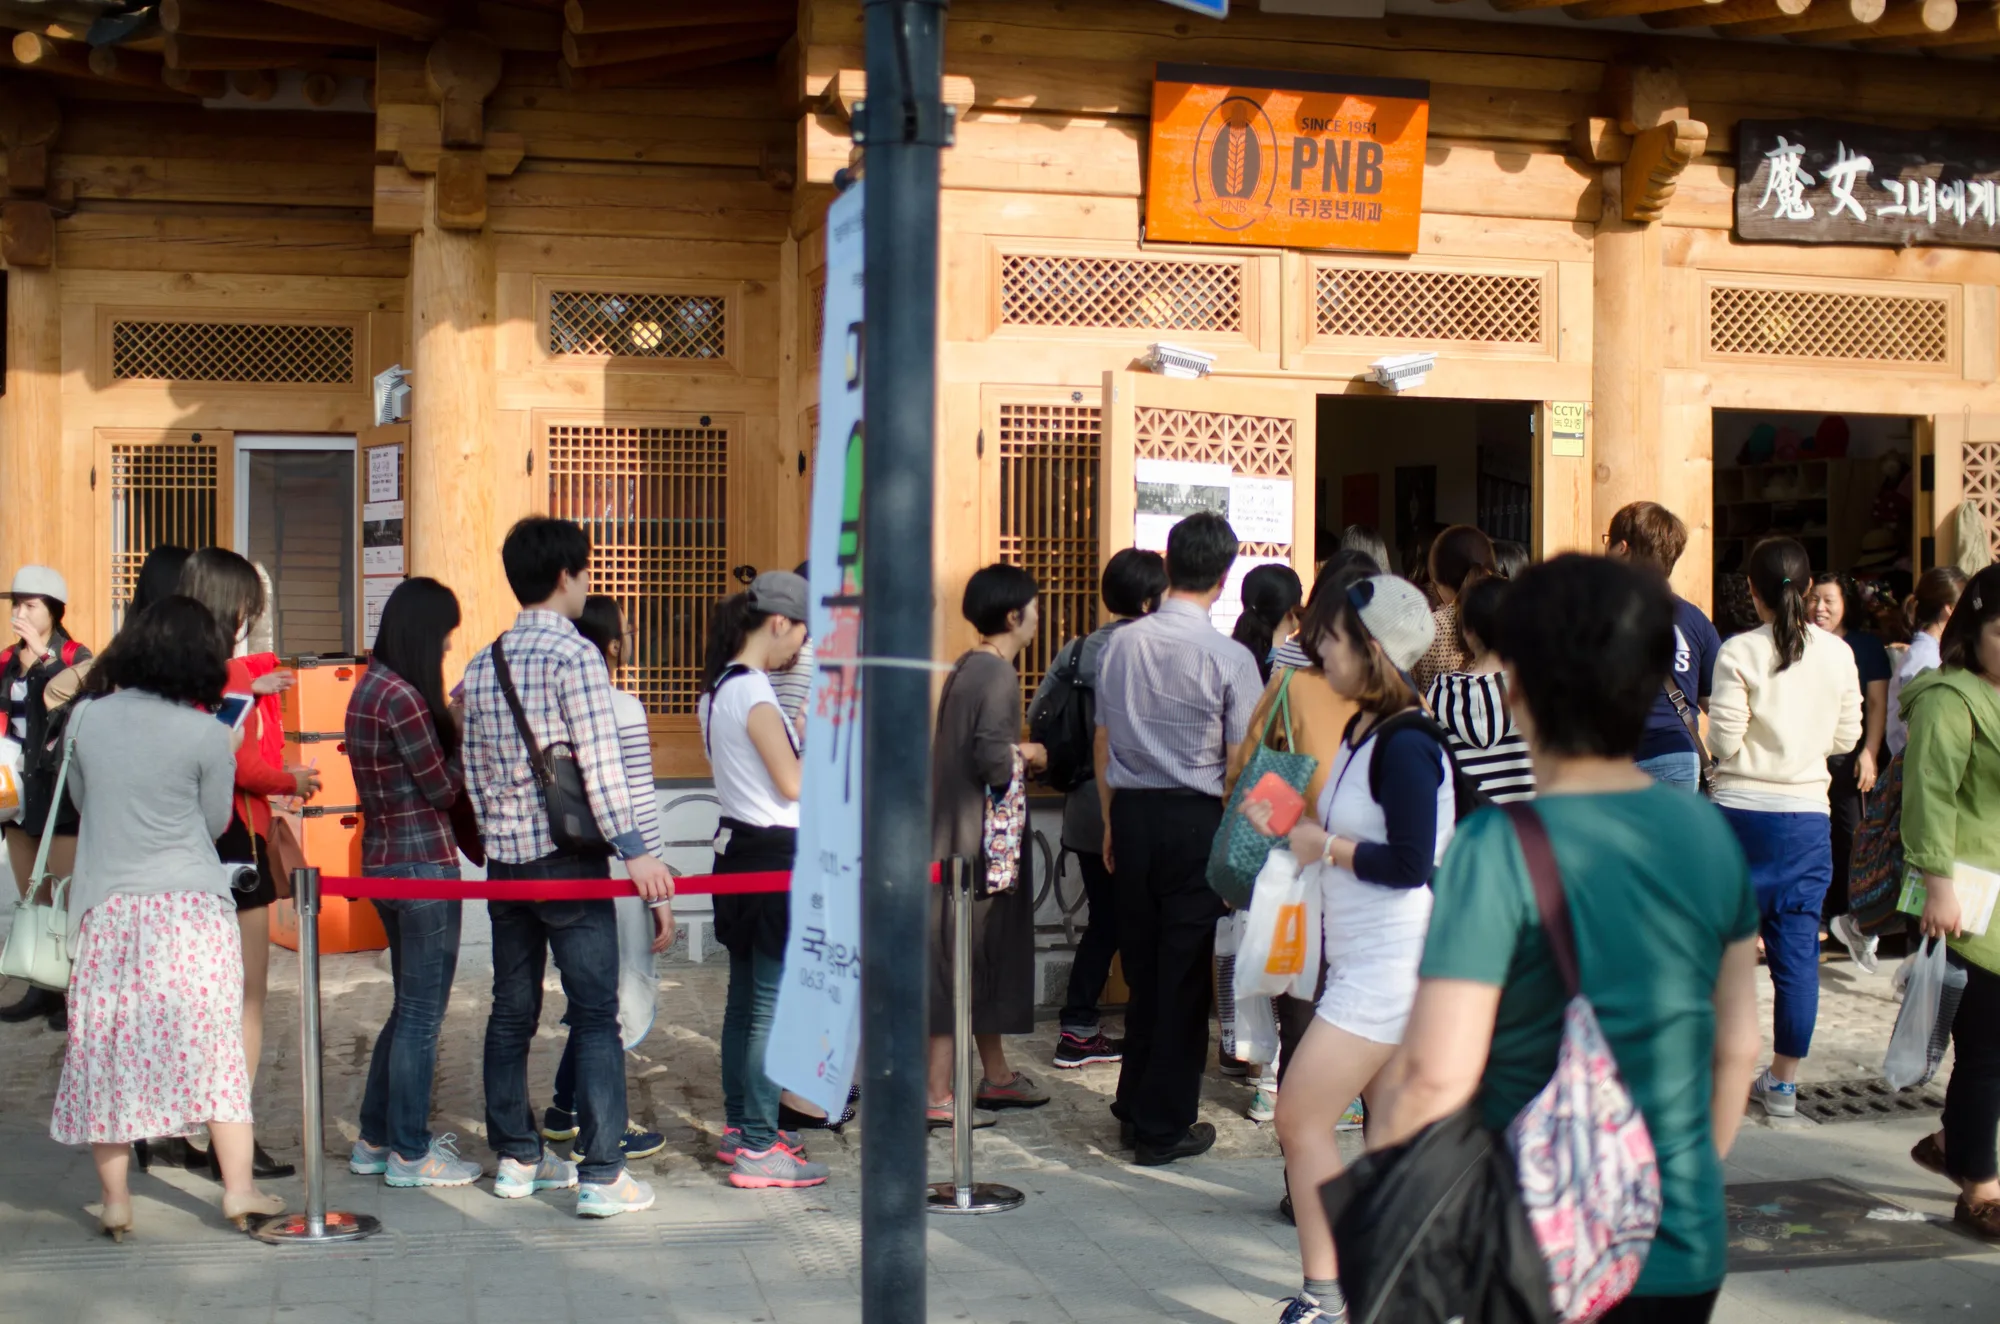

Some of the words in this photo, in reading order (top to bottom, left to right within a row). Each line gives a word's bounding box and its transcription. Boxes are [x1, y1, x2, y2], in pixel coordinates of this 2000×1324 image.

[1301, 117, 1342, 132] SINCE
[1347, 120, 1377, 135] 1951
[1290, 136, 1384, 195] PNB
[1757, 135, 1875, 223] 魔女
[1876, 176, 2000, 228] 그녀에게
[1220, 199, 1247, 213] PNB
[1288, 197, 1383, 222] (주)풍년제과
[1554, 405, 1582, 416] CCTV
[1554, 418, 1582, 429] 녹화중
[1674, 650, 1691, 672] S
